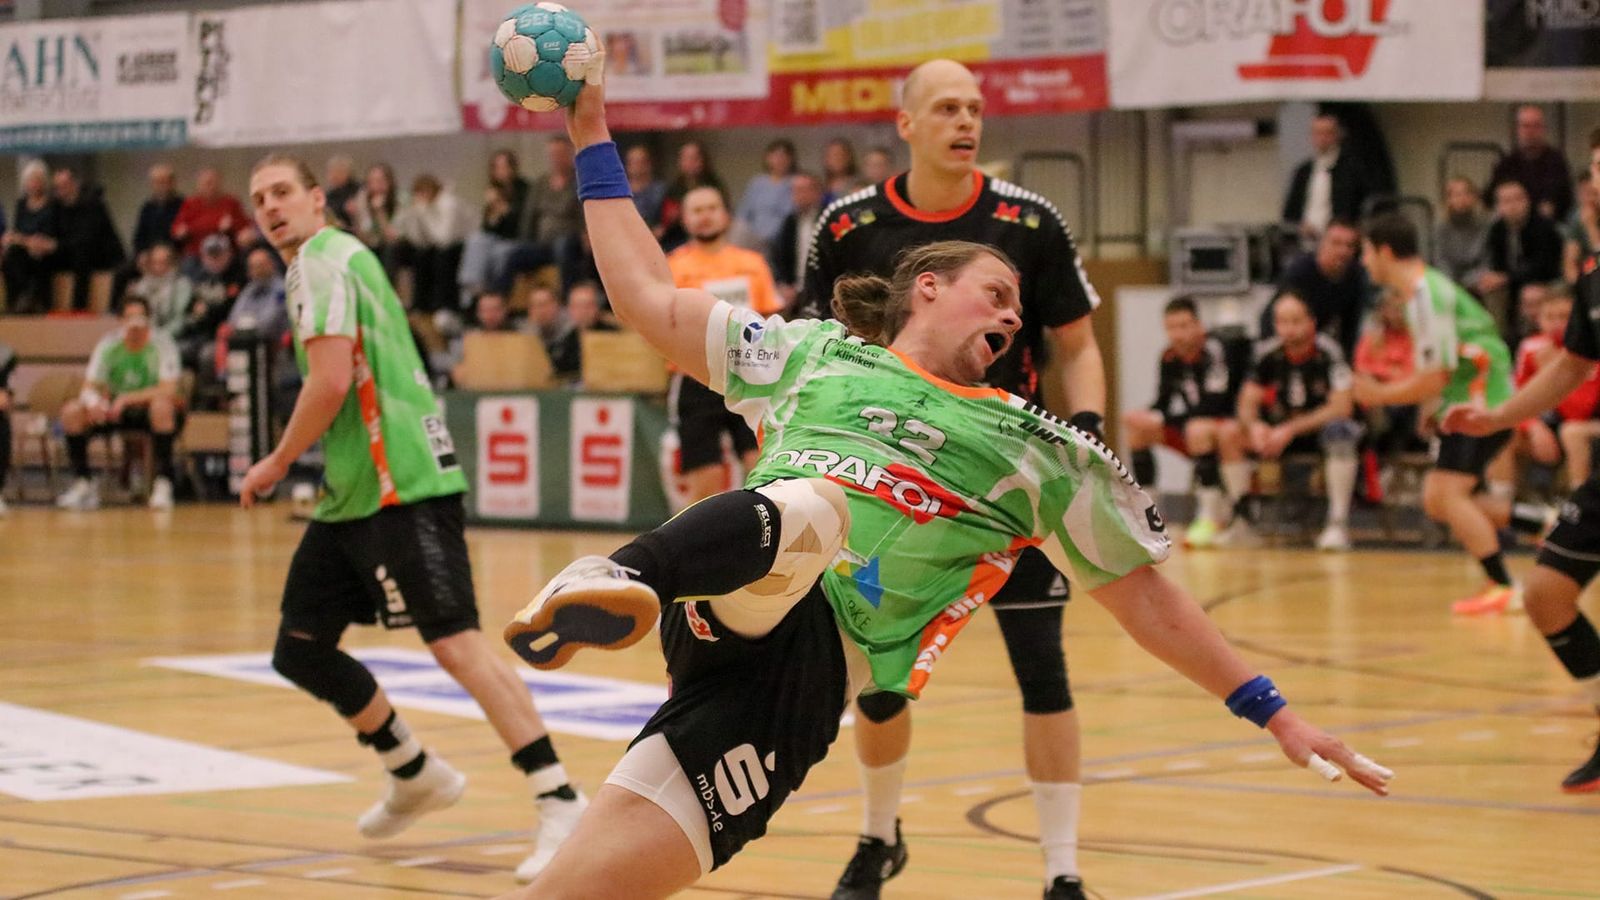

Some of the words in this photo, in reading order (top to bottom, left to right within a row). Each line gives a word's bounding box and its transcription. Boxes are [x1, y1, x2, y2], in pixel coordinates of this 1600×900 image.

[834, 348, 876, 370] Kliniken
[859, 406, 947, 465] 32
[756, 503, 772, 548] SELECT
[696, 773, 724, 833] mbsde
